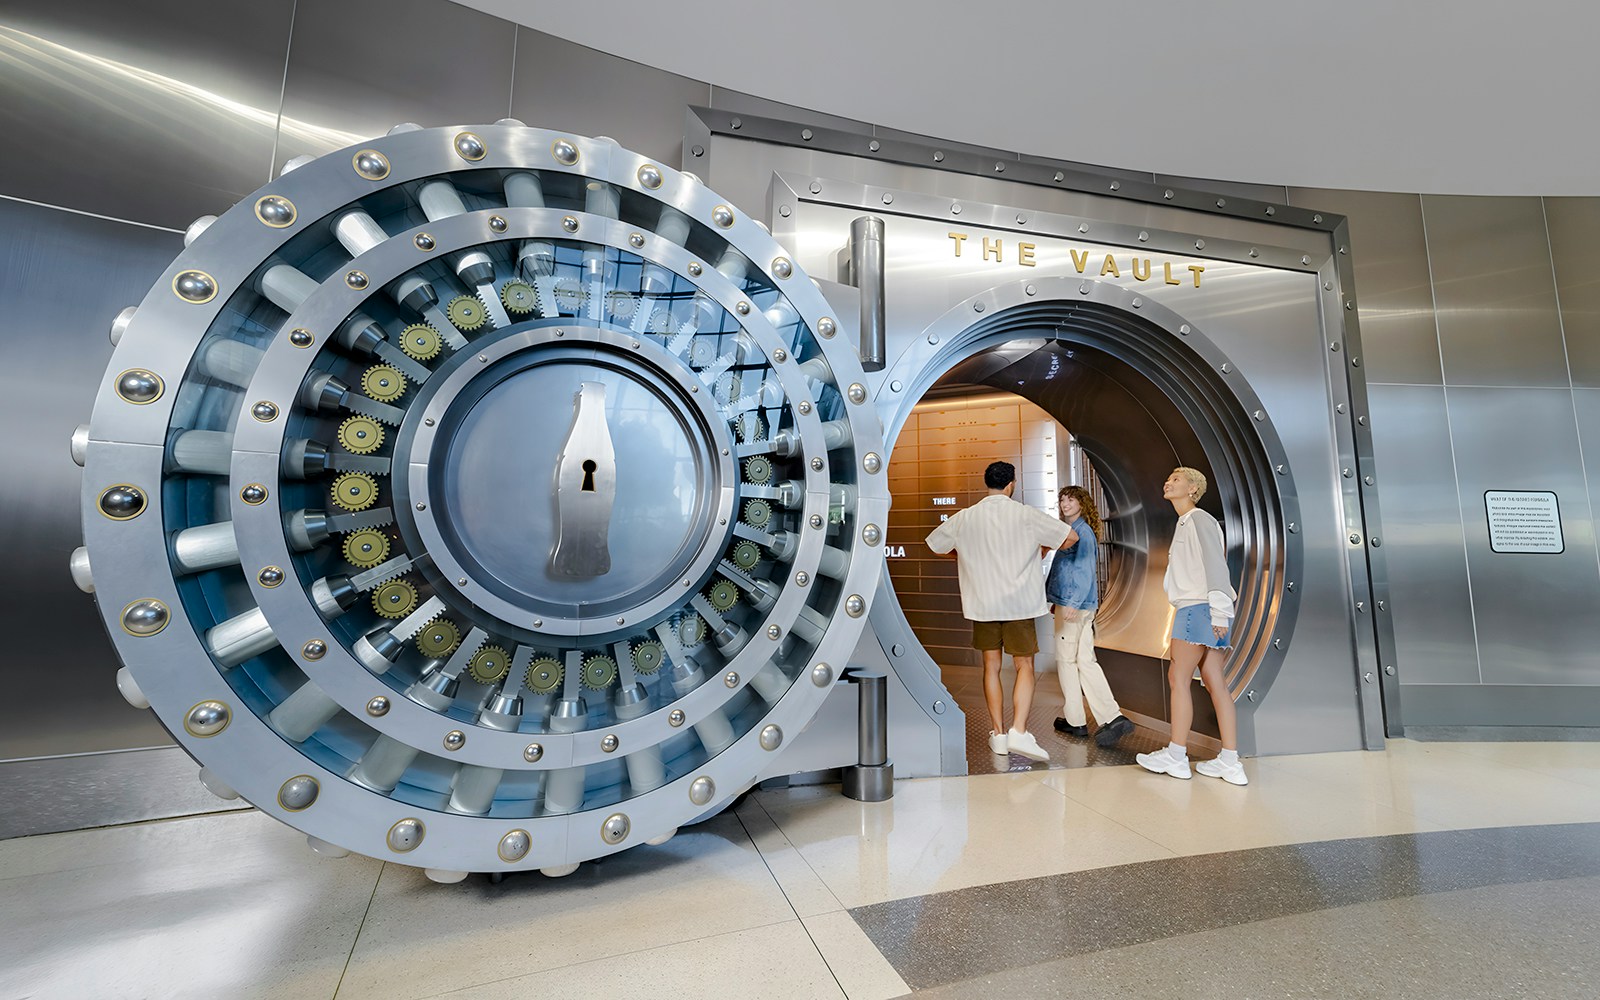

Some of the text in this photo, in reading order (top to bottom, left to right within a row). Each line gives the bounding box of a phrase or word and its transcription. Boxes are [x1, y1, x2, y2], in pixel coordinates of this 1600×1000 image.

[948, 232, 1205, 288] THE VAULT
[932, 497, 956, 505] THERE
[940, 514, 949, 522] IS
[883, 546, 906, 557] OLA
